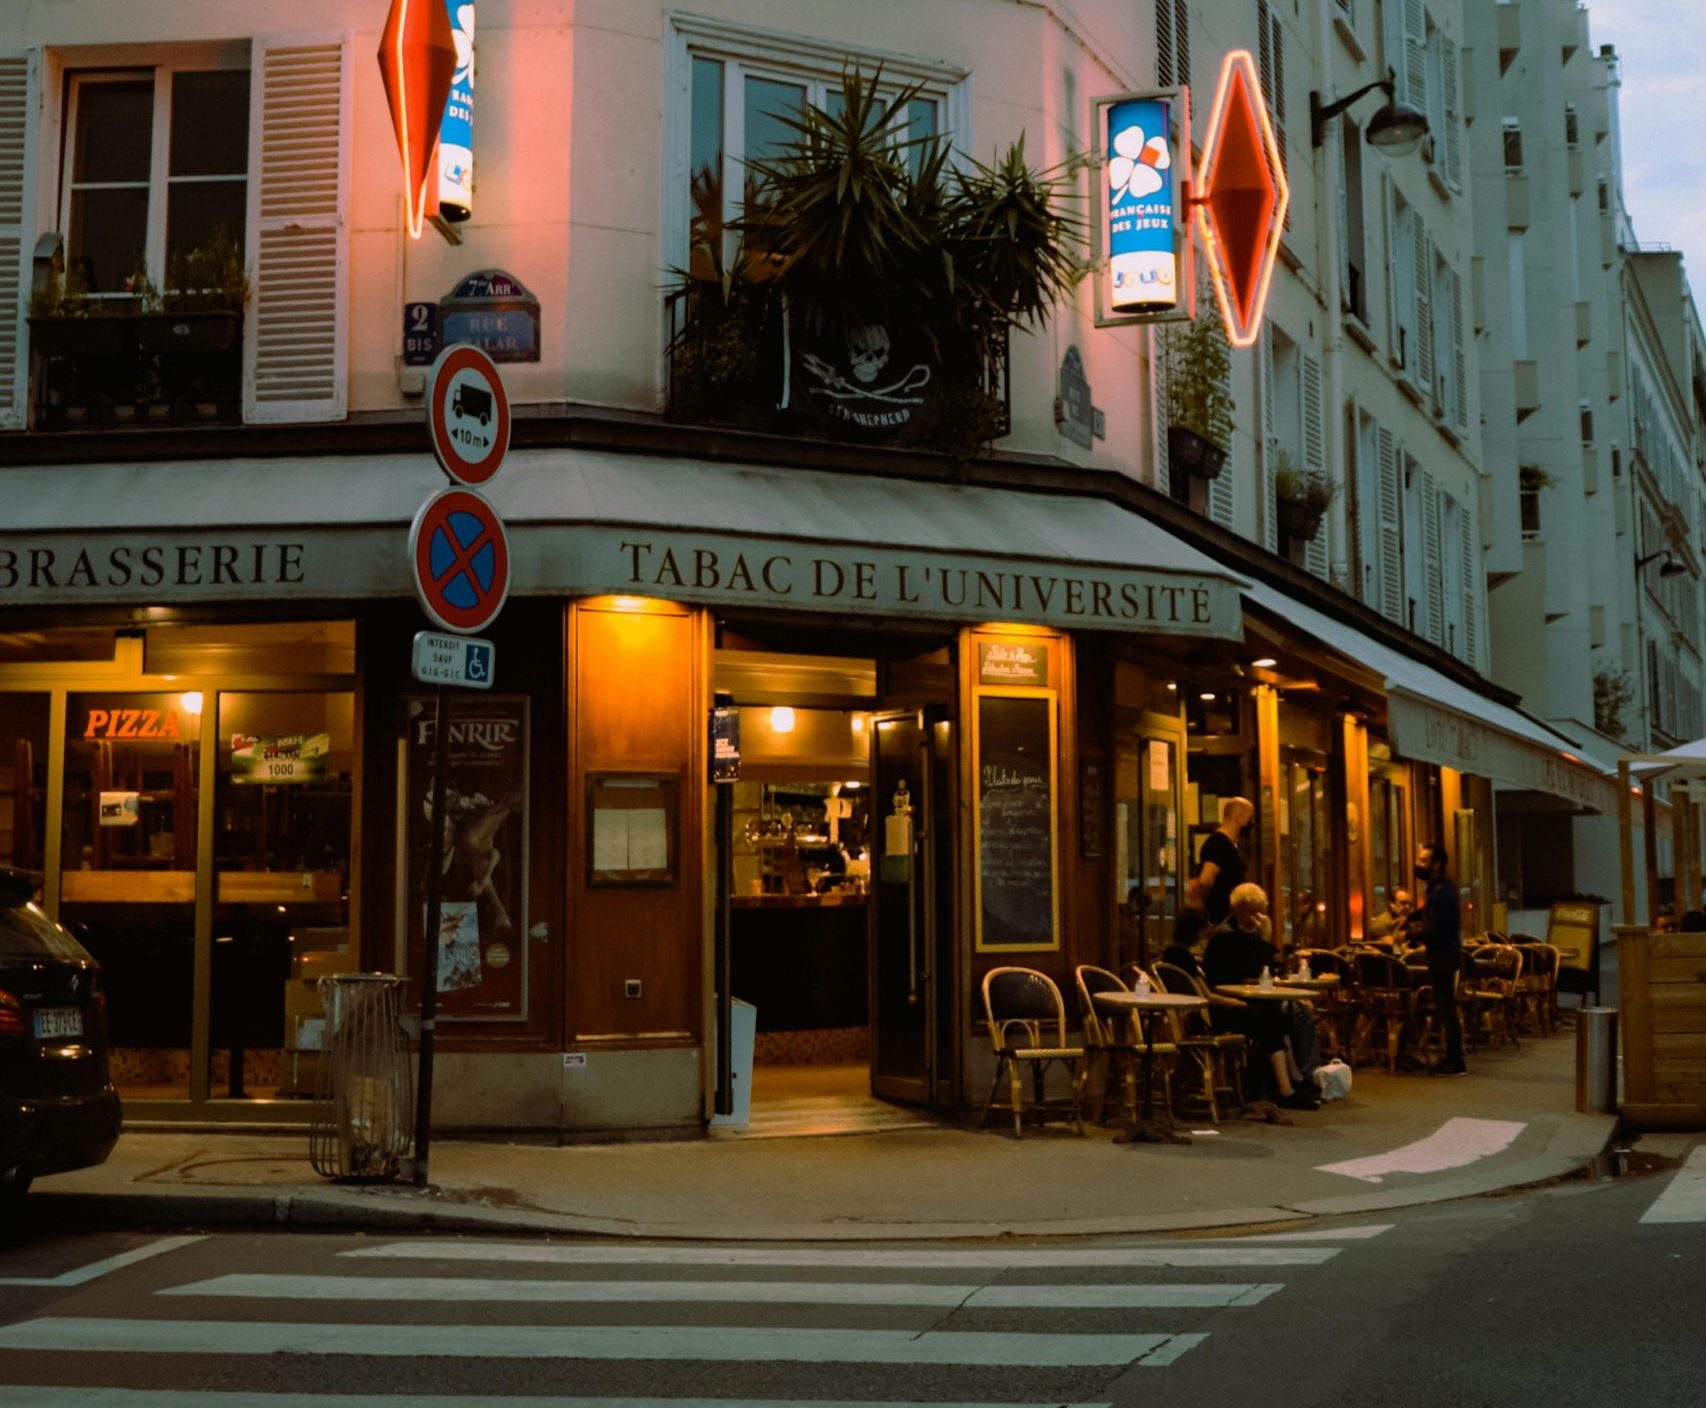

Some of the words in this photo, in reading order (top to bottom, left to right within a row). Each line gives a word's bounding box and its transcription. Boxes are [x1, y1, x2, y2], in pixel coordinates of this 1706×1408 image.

[1136, 218, 1168, 231] JEUX
[411, 304, 428, 331] 2
[470, 317, 506, 333] RUE
[408, 338, 433, 352] BIS
[0, 543, 304, 589] BRASSERIE
[620, 539, 792, 596] TABAC
[812, 557, 878, 601] DE
[896, 566, 1212, 624] L'UNIVERSITÉ
[427, 637, 461, 651] INTERDIT
[433, 653, 453, 665] SAUF
[84, 709, 179, 738] PIZZA
[416, 718, 520, 751] FNRIR
[268, 763, 294, 776] 1000
